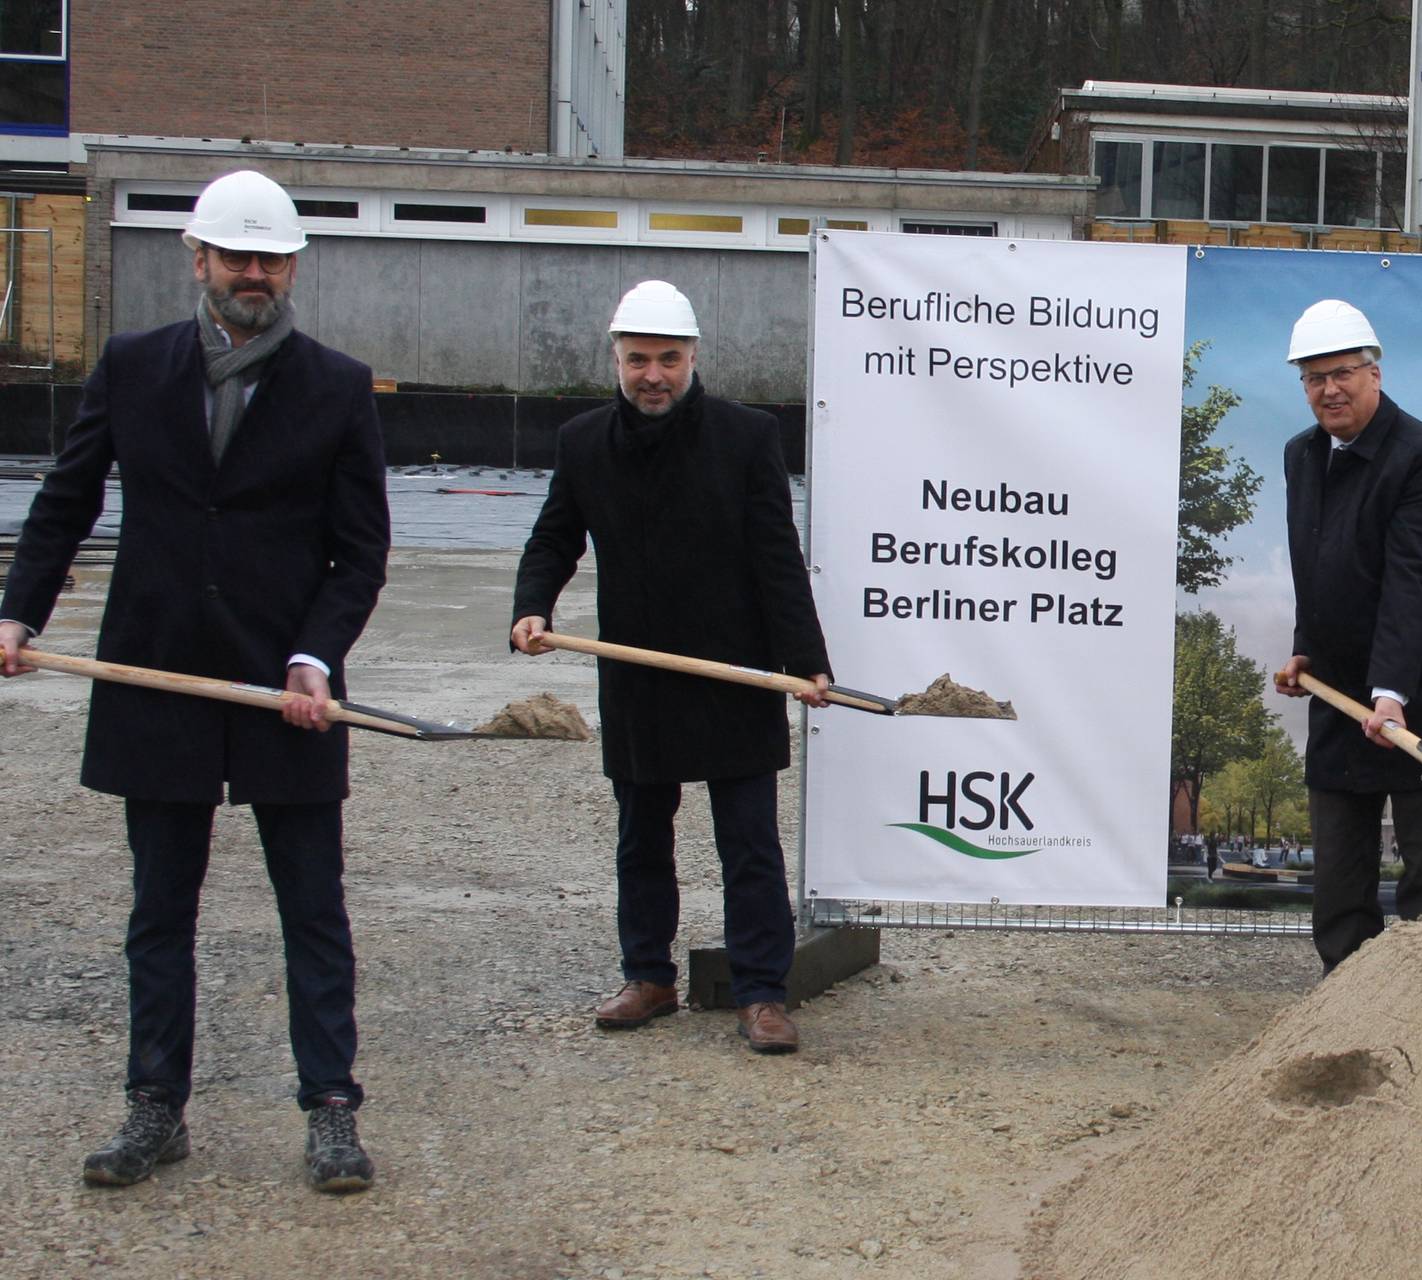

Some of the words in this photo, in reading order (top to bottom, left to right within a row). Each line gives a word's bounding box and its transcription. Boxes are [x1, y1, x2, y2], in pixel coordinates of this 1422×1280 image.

[842, 287, 1016, 325] Berufliche
[1029, 296, 1159, 339] Bildung
[864, 345, 916, 376] mit
[928, 347, 1134, 388] Perspektive
[922, 479, 1069, 516] Neubau
[871, 532, 1118, 580] Berufskolleg
[863, 587, 1018, 622] Berliner
[1030, 593, 1124, 627] Platz
[919, 770, 1035, 831] HSK
[988, 834, 1092, 848] Hochsauerlandkreis
